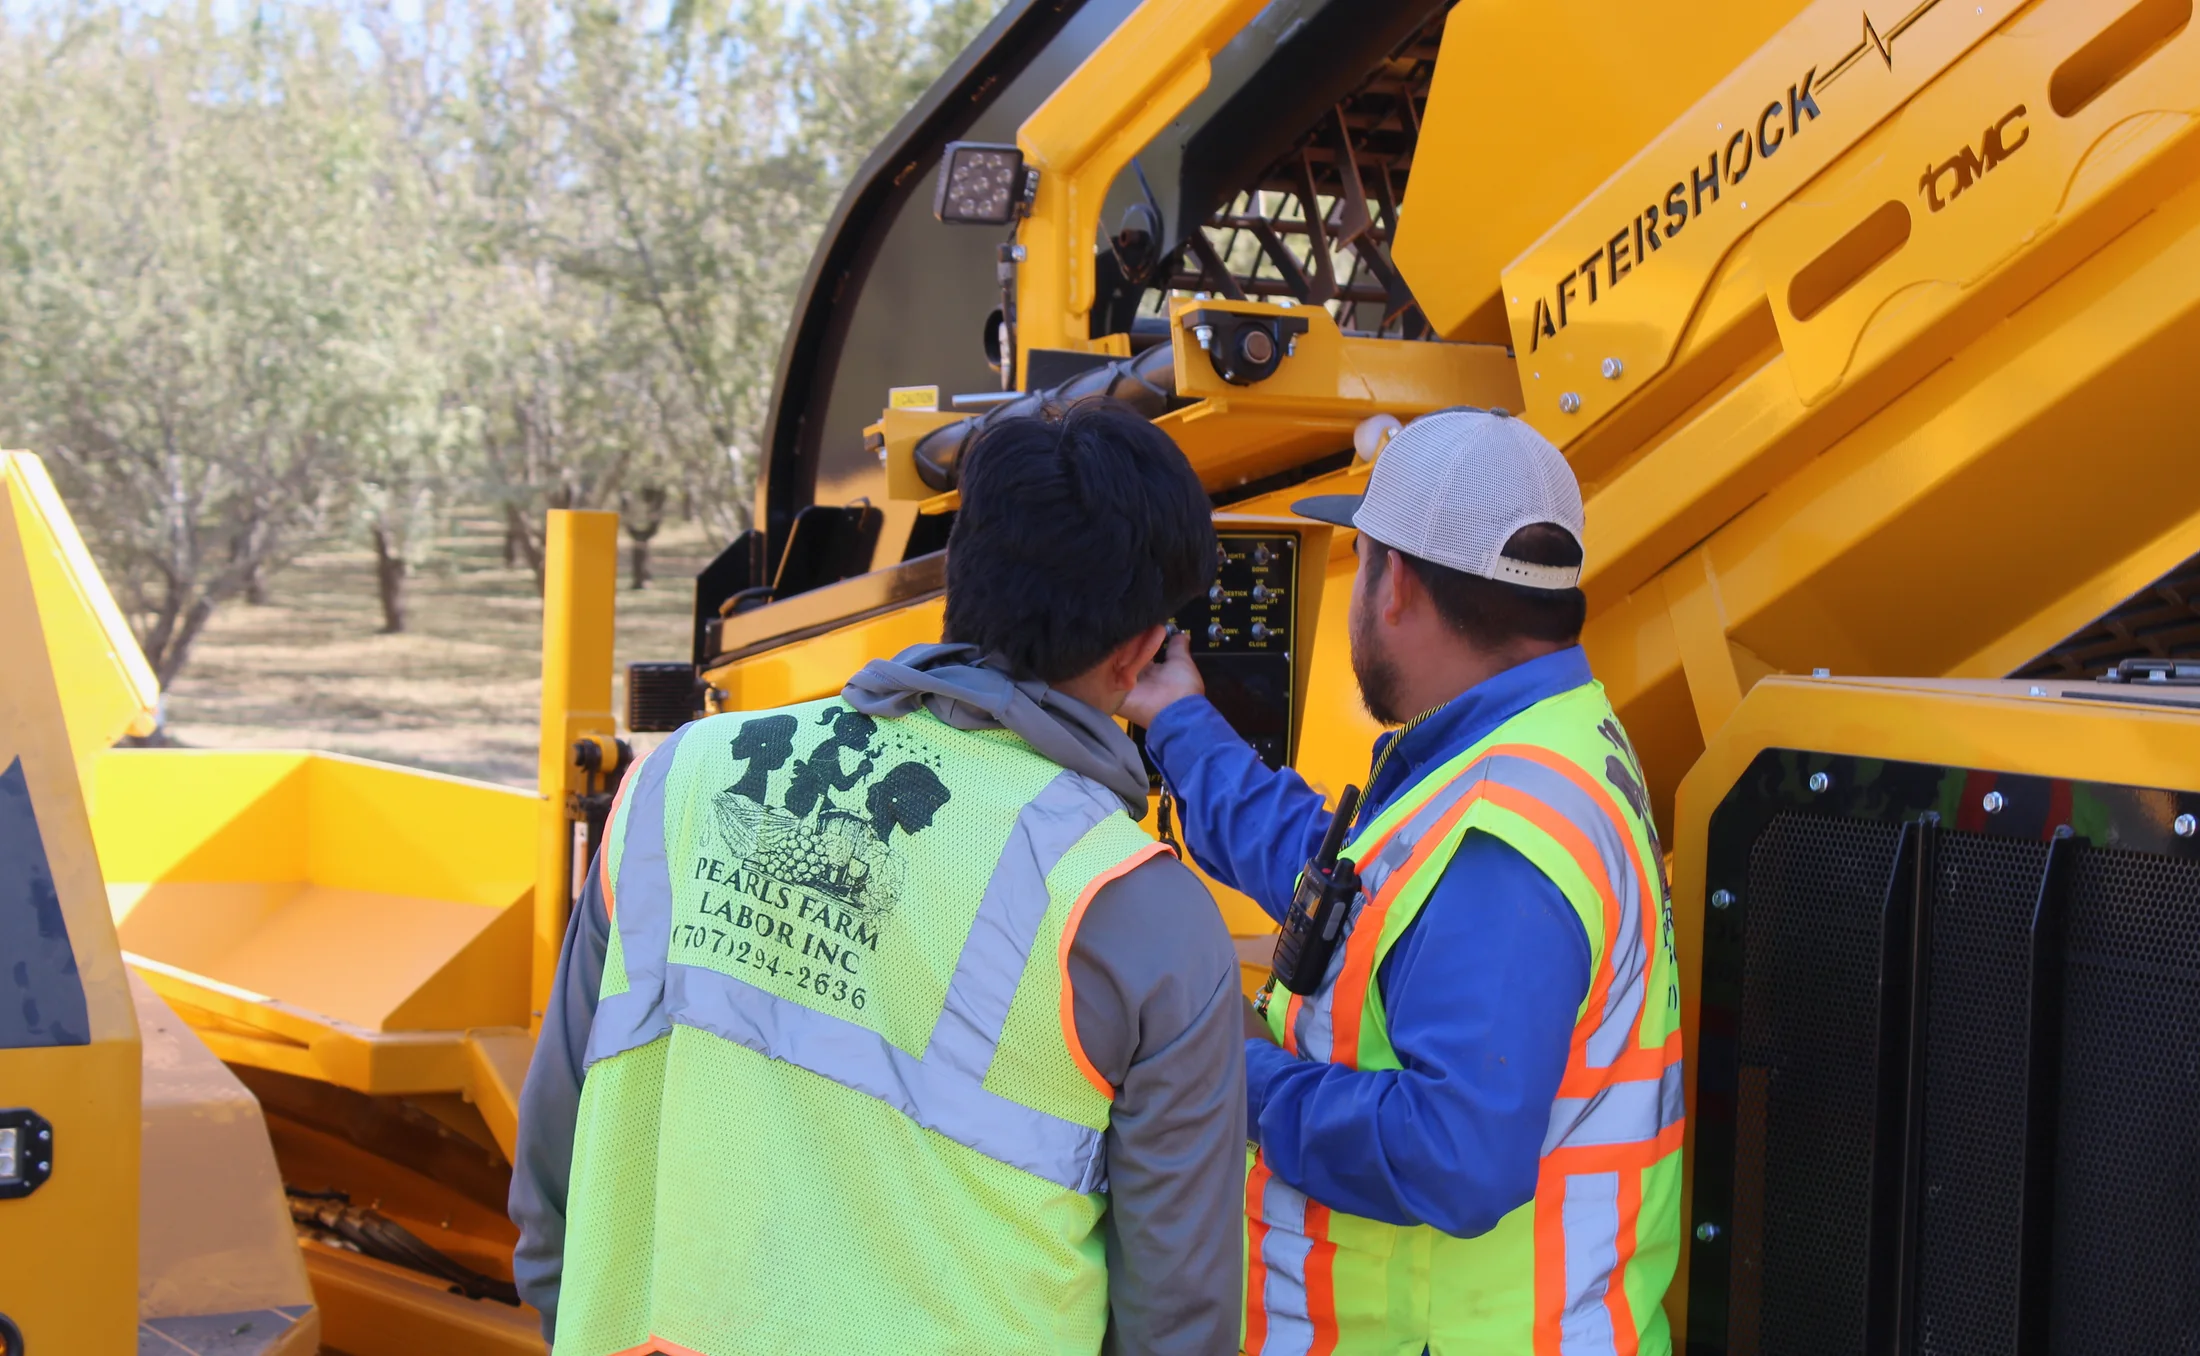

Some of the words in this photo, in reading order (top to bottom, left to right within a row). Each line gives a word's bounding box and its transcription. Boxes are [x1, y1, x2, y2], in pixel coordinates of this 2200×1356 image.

[1529, 65, 1821, 354] AFTERSHOCK
[694, 857, 791, 909] PEARLS
[797, 896, 879, 952] FARM
[700, 891, 794, 949] LABOR
[802, 933, 860, 974] INC
[672, 924, 867, 1010] (707)294-2636
